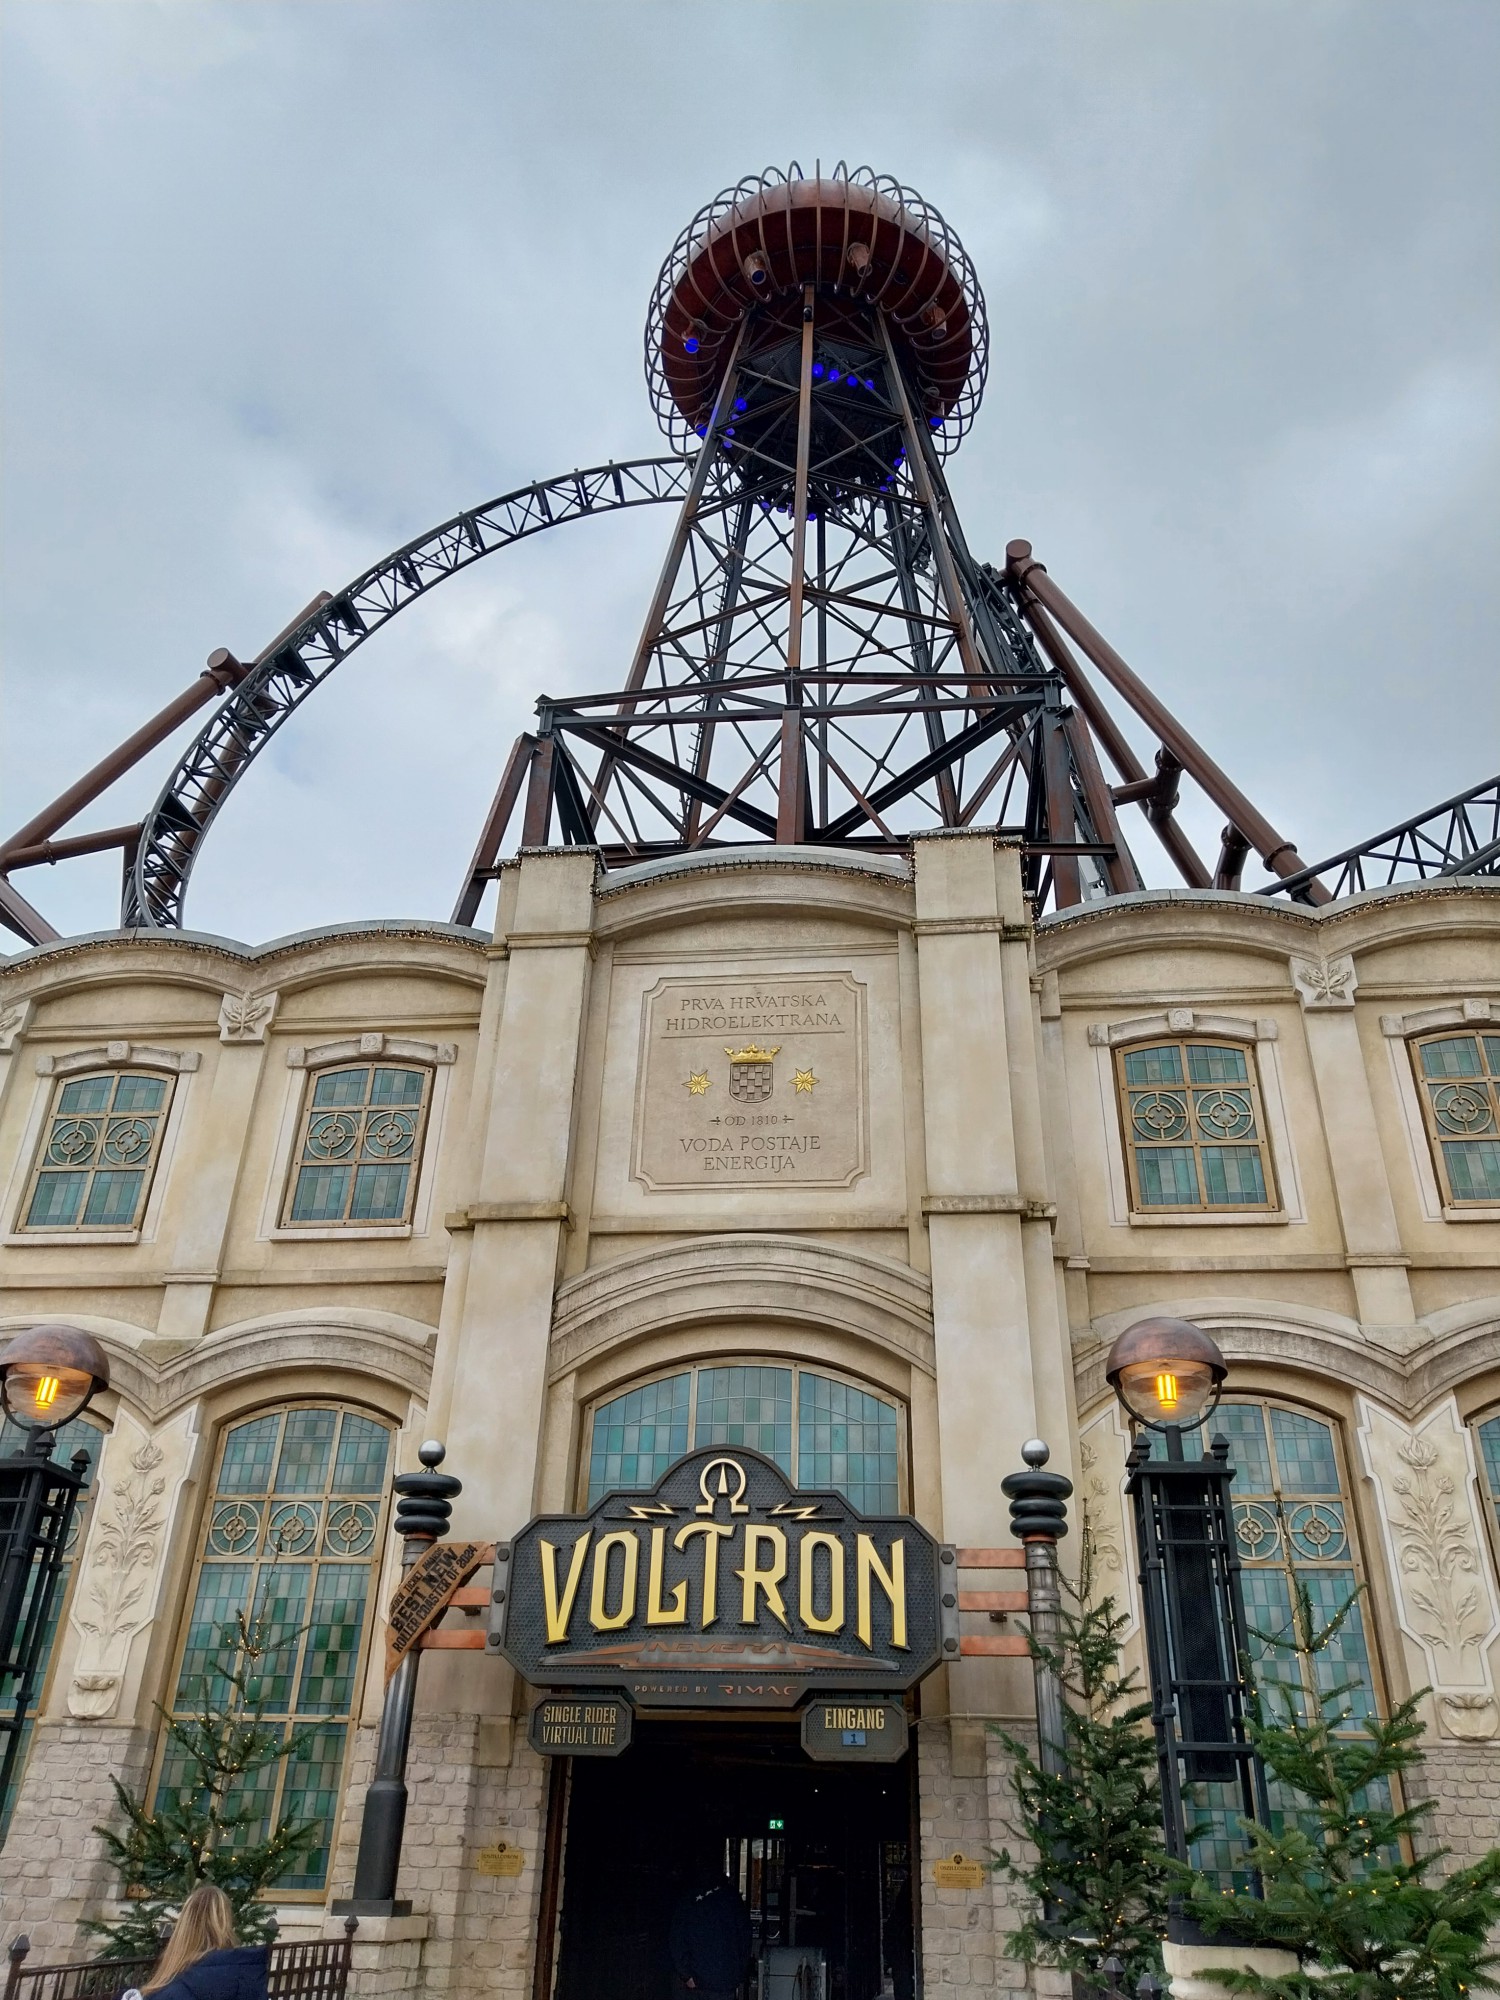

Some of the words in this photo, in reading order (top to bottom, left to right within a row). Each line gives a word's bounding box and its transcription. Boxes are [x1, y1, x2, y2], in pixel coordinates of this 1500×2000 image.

[680, 998, 725, 1011] PRVA
[730, 994, 827, 1009] HRVATSKA
[666, 1013, 842, 1031] HIDROELEKTRANA
[724, 1116, 746, 1126] OD
[751, 1115, 778, 1125] 1810
[680, 1138, 733, 1153] VODA
[740, 1135, 821, 1153] POSTAJE
[703, 1155, 795, 1173] ENERGIJA
[390, 1586, 428, 1633] BEST
[421, 1547, 459, 1590] NEW
[539, 1521, 911, 1651] VOLTRON
[392, 1617, 422, 1653] ROLLER
[416, 1578, 452, 1620] COASTER
[446, 1566, 460, 1581] OF
[456, 1544, 478, 1569] 2024
[634, 1685, 688, 1693] POWERED
[718, 1685, 798, 1695] RIMAC
[543, 1706, 581, 1723] SINGLE
[584, 1707, 617, 1724] RIDER
[824, 1708, 885, 1730] EINGANG
[543, 1726, 588, 1744] VIRTUAL
[592, 1727, 616, 1745] LINE
[850, 1733, 857, 1744] 1
